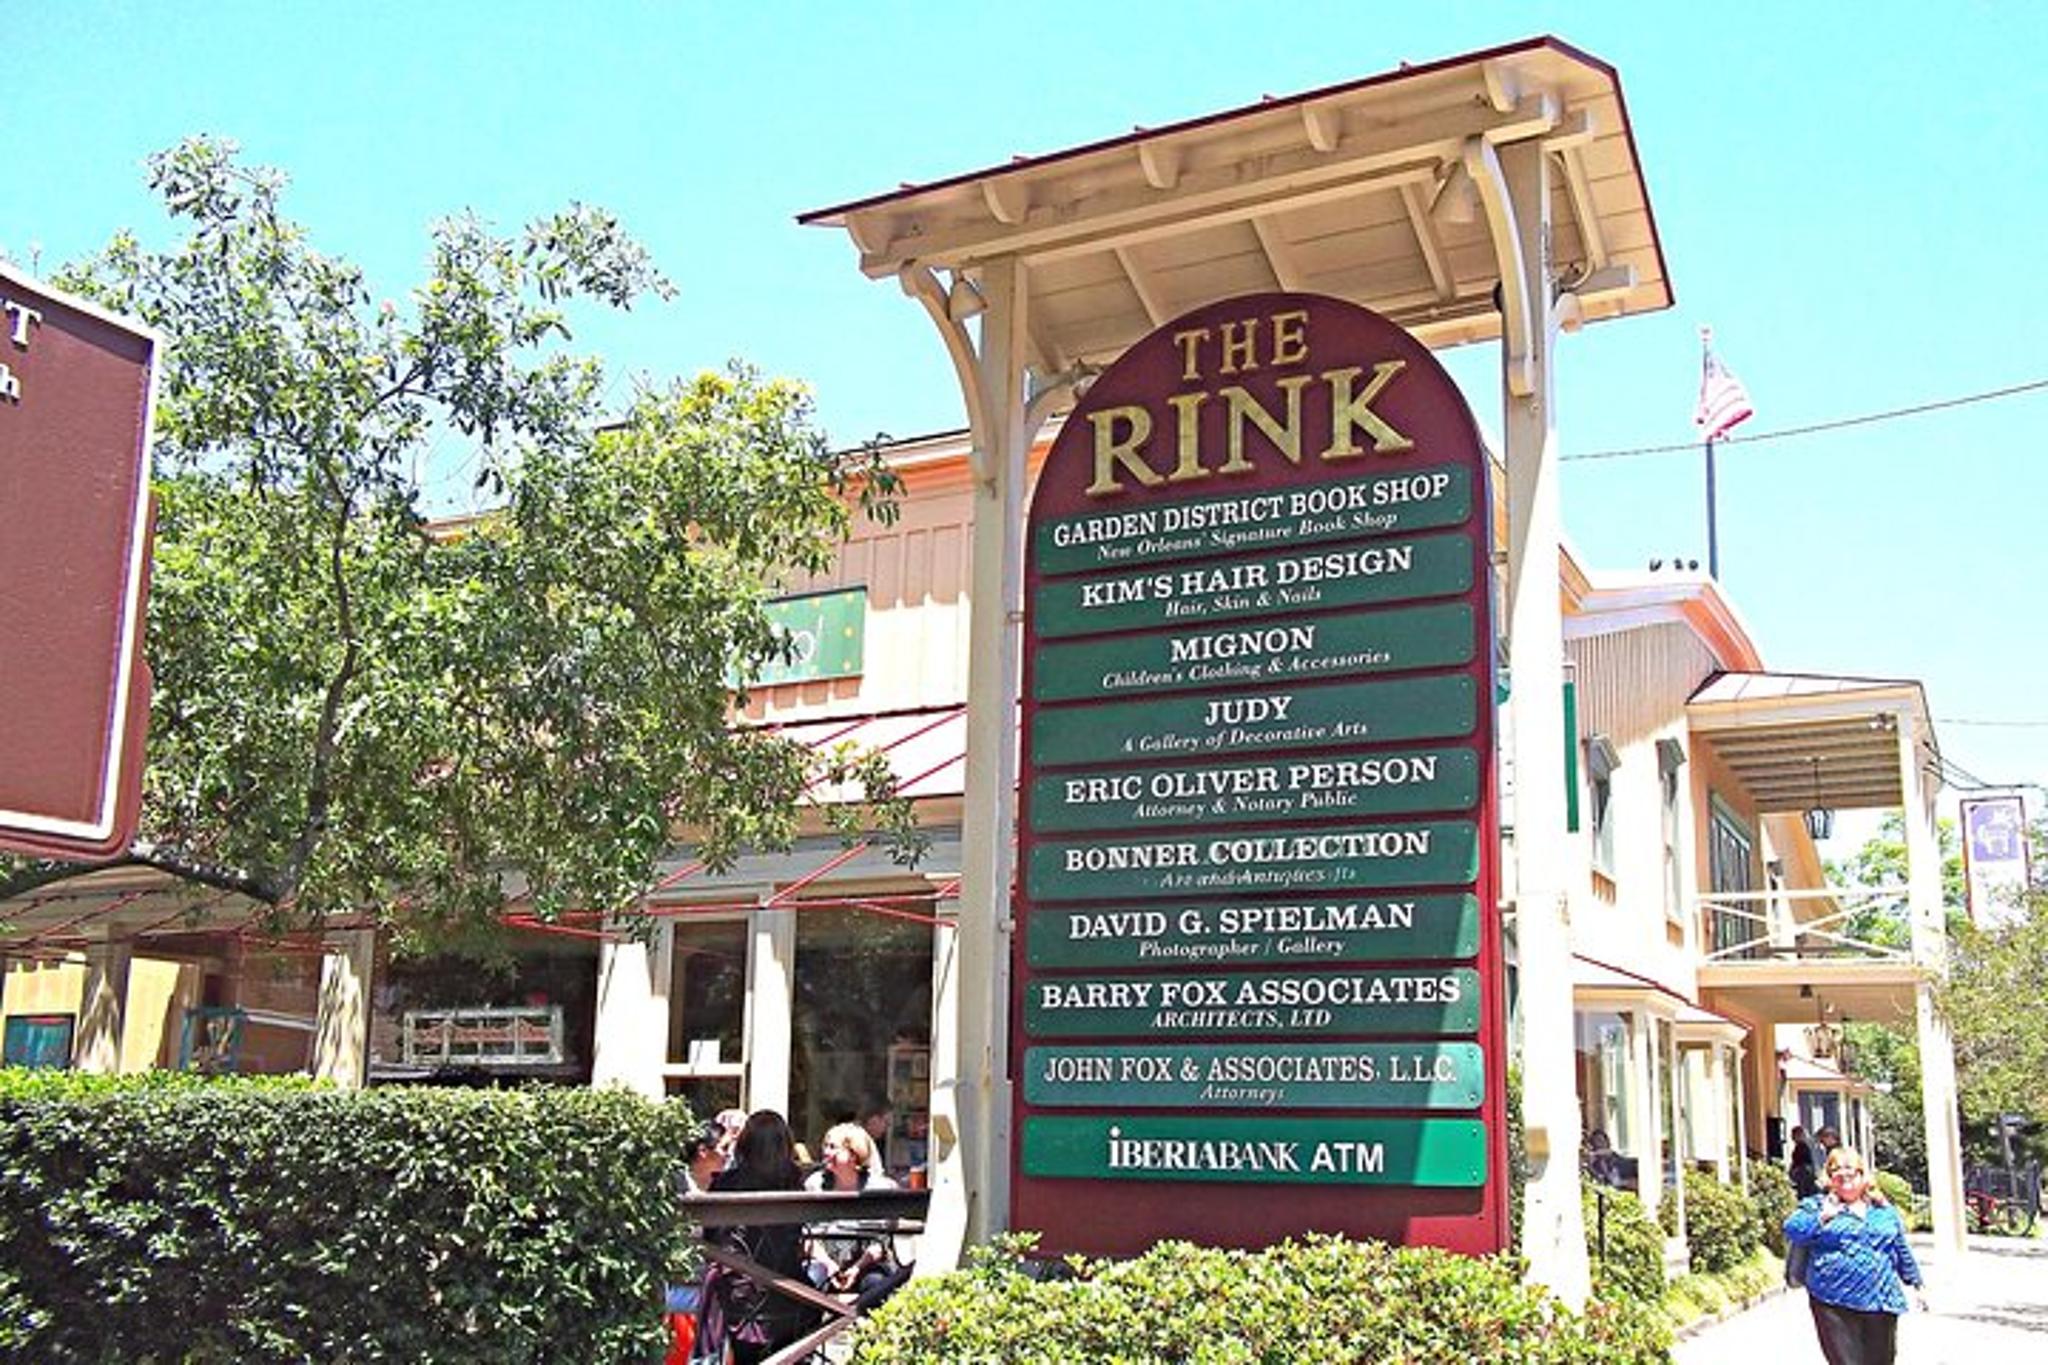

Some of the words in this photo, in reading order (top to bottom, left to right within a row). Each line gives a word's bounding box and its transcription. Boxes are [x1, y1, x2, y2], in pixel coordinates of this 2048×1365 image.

[1174, 310, 1310, 381] THE
[1084, 360, 1415, 495] RINK
[1054, 511, 1157, 547] GARDEN
[1163, 495, 1284, 532] DISTRICT
[1290, 484, 1368, 516] BOOK
[1373, 474, 1449, 505] SHOP
[1097, 545, 1131, 561] New
[1210, 525, 1292, 549] Signature
[1299, 515, 1346, 536] Book
[1351, 511, 1398, 530] Shop
[1081, 573, 1173, 607] KIM'S
[1180, 564, 1269, 596] HAIR
[1276, 546, 1413, 584] DESIGN
[1165, 599, 1208, 617] Hair,
[1211, 595, 1251, 612] Skin
[1256, 592, 1271, 607] &
[1278, 585, 1322, 605] Nails
[1170, 625, 1316, 663] MIGNON
[1102, 666, 1182, 689] Children's
[1188, 661, 1263, 681] Clothing
[1268, 656, 1284, 674] &
[1287, 647, 1391, 672] Accessories
[1205, 696, 1292, 726] JUDY
[1120, 737, 1134, 752] A
[1139, 733, 1199, 753] Gallery
[1205, 730, 1228, 750] of
[1229, 723, 1326, 745] Decorative
[1331, 720, 1368, 738] Arts
[1065, 775, 1142, 803] ERIC
[1151, 766, 1280, 798] OLIVER
[1288, 756, 1438, 789] PERSON
[1133, 802, 1207, 820] Attorney
[1211, 799, 1227, 815] &
[1233, 796, 1294, 815] Notary
[1300, 791, 1358, 808] Public
[1065, 843, 1199, 871] BONNER
[1208, 830, 1431, 865] COLLECTION
[1069, 911, 1167, 939] DAVID
[1179, 909, 1211, 935] G.
[1219, 903, 1415, 933] SPIELMAN
[1138, 938, 1259, 960] Photographer
[1277, 936, 1345, 956] Gallery
[1041, 982, 1152, 1009] BARRY
[1160, 981, 1228, 1007] FOX
[1235, 977, 1460, 1005] ASSOCIATES
[1152, 1009, 1284, 1028] ARCHITECTS,
[1290, 1008, 1332, 1027] LTD
[1043, 1056, 1113, 1082] JOHN
[1120, 1056, 1173, 1082] FOX
[1179, 1056, 1199, 1082] &
[1200, 1083, 1285, 1105] Attorneys
[1310, 1142, 1384, 1173] ATM
